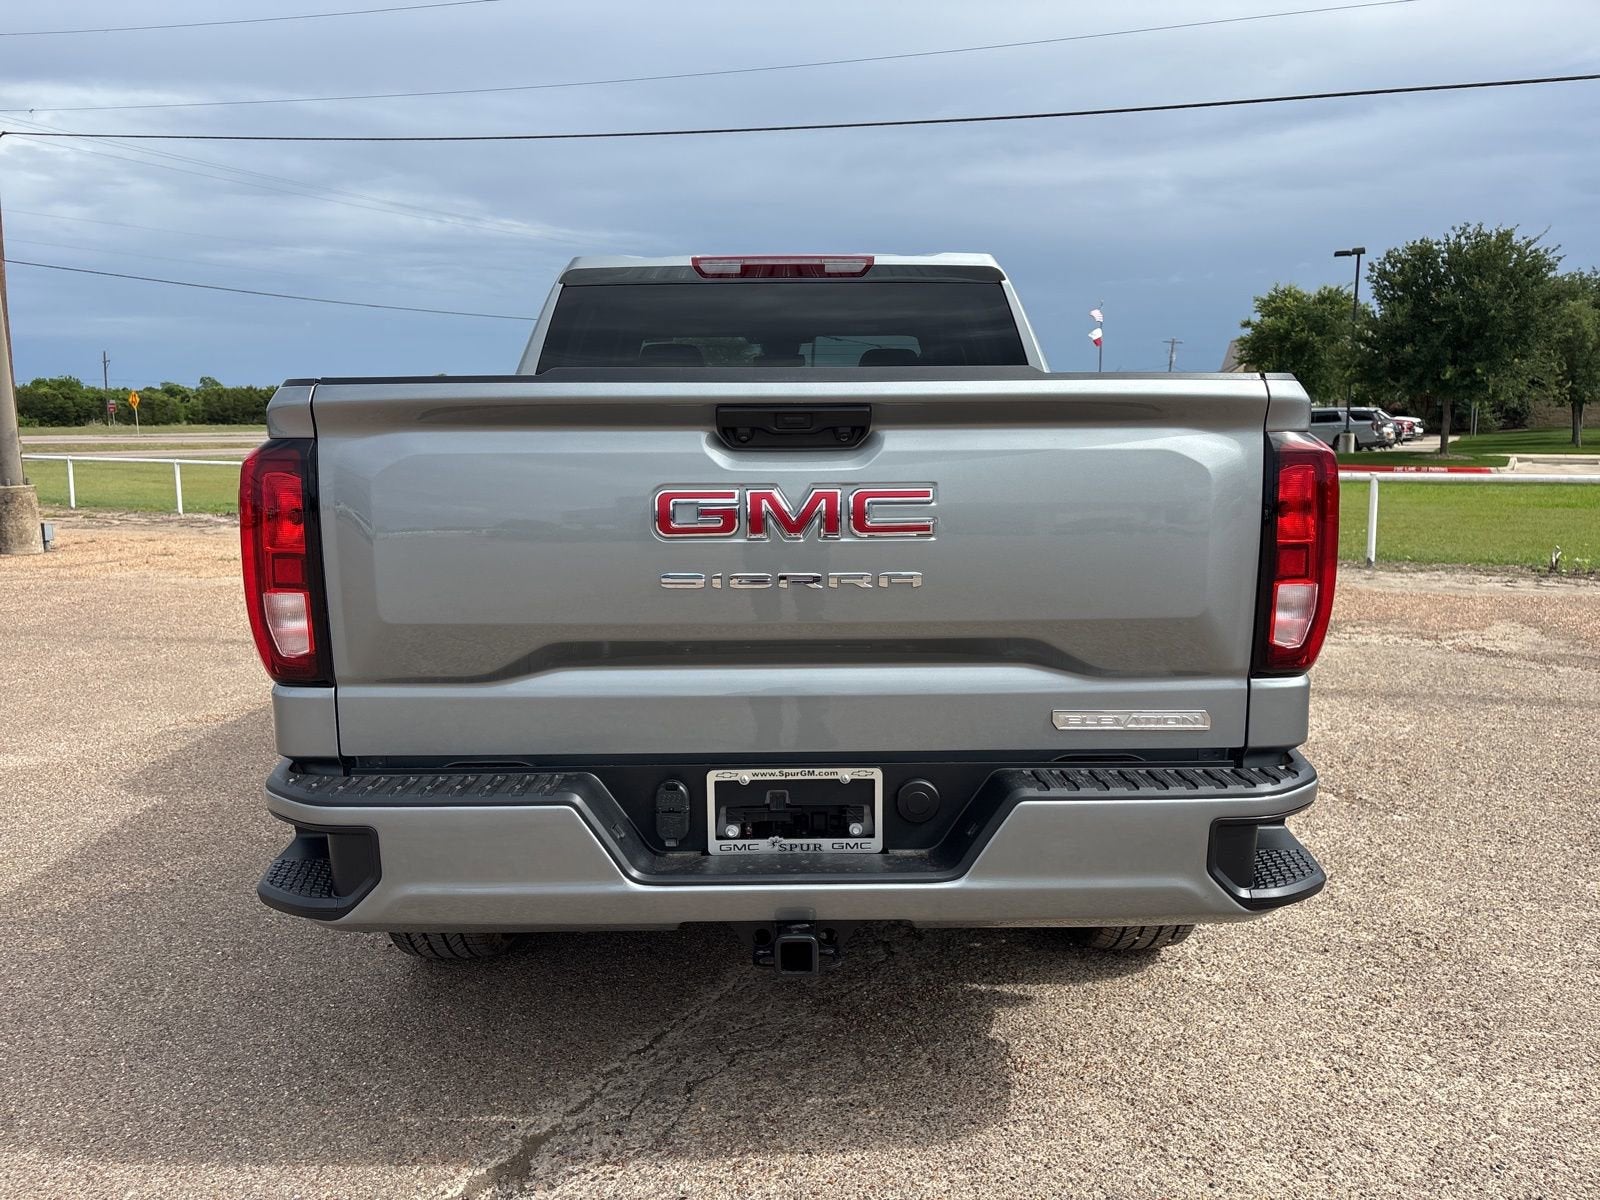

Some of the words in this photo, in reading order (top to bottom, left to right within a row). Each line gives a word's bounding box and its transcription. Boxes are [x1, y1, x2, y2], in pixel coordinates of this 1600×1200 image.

[655, 488, 936, 541] GMC
[660, 572, 923, 589] SIERRA
[1063, 714, 1202, 727] ELEVATION
[751, 770, 839, 778] www.SpurGM.com
[719, 843, 760, 852] GMC
[778, 843, 824, 852] SPUR
[831, 842, 872, 850] GMC
